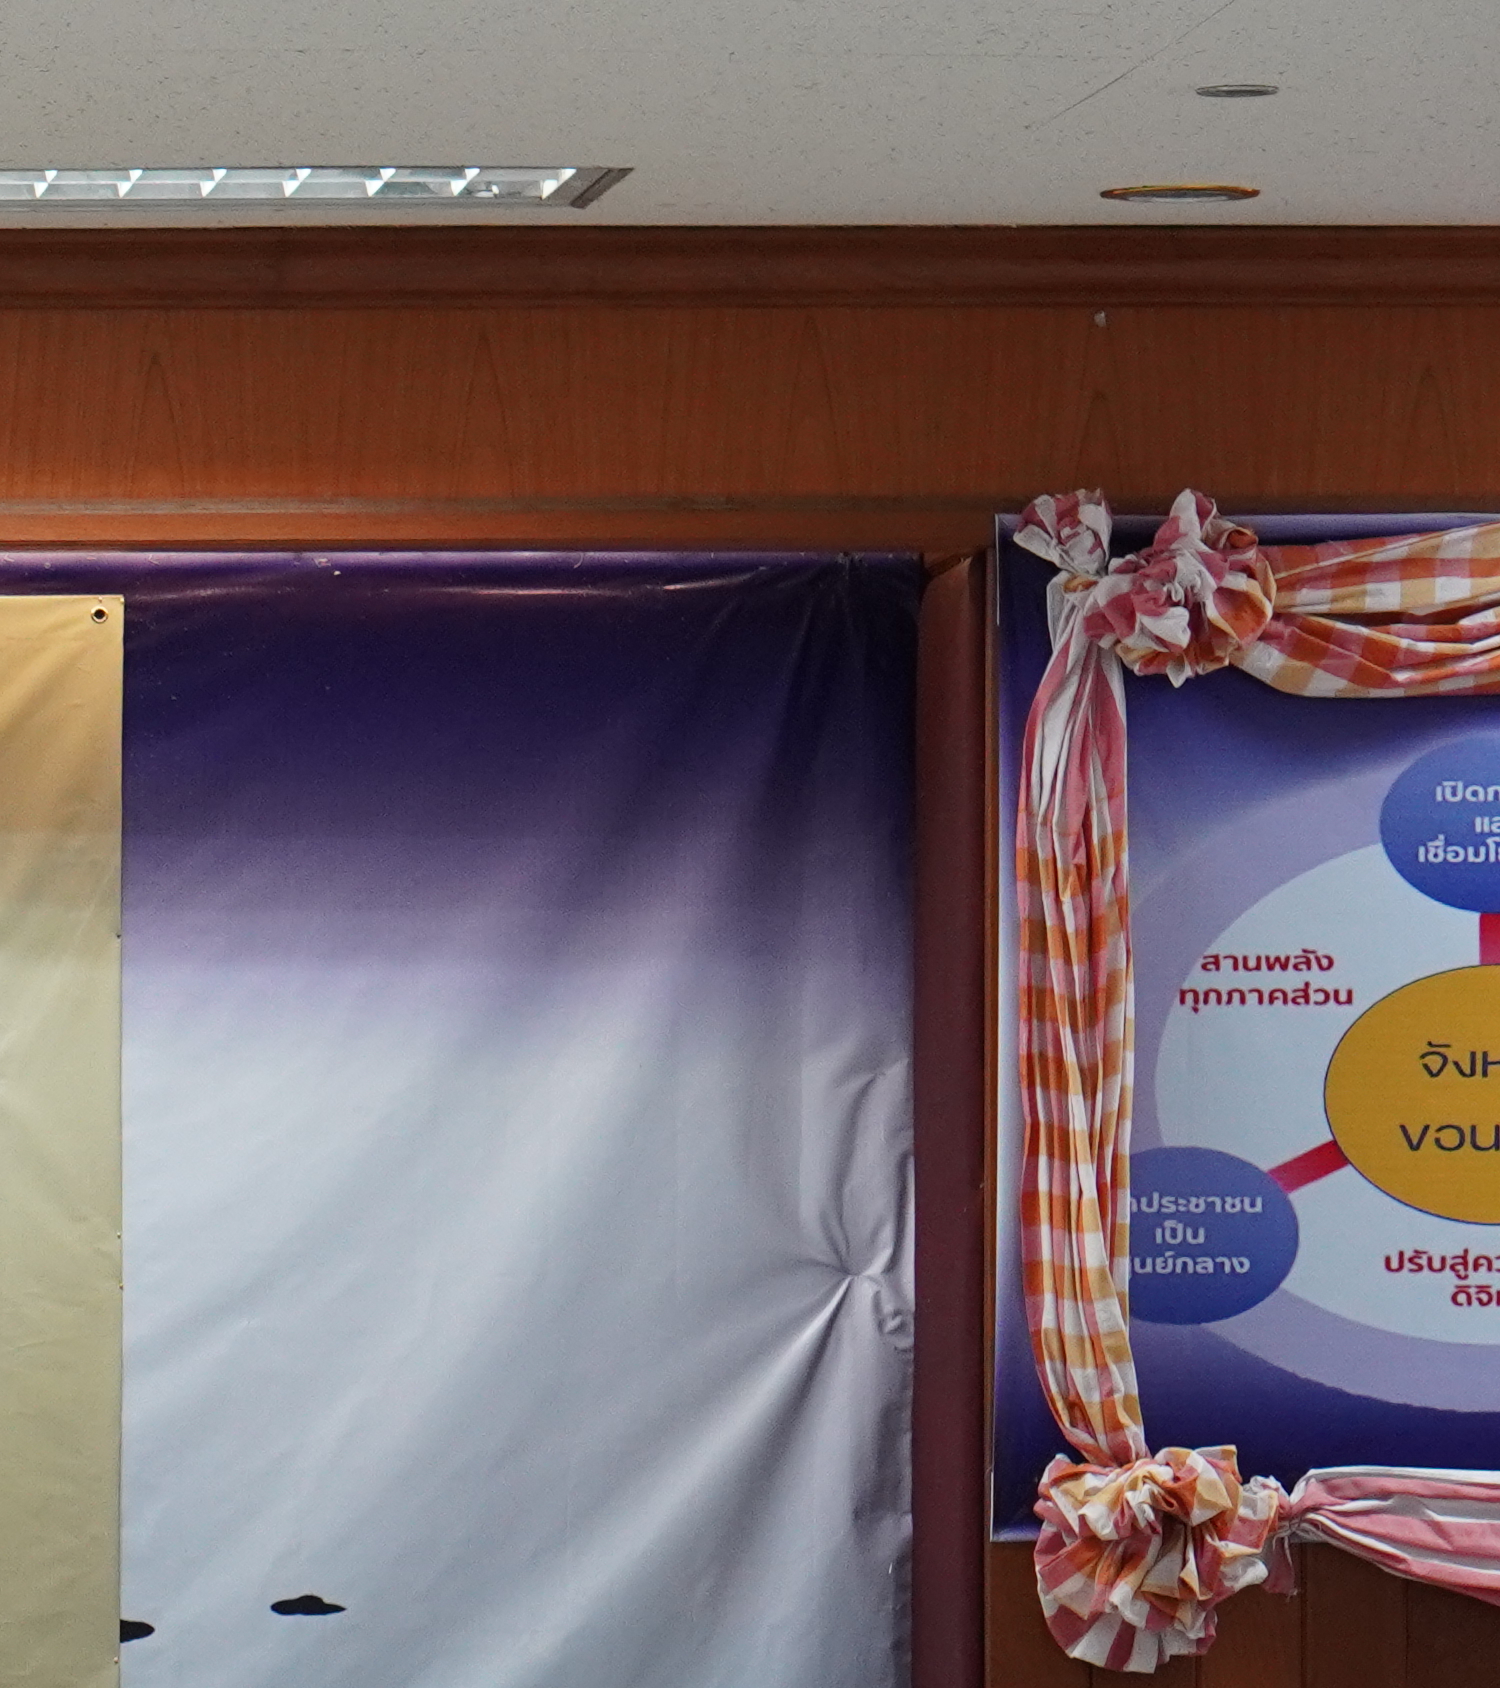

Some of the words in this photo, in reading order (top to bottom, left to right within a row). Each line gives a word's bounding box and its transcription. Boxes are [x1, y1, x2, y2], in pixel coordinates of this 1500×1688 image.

[1417, 833, 1500, 863] เชื่อมโ
[1200, 948, 1336, 973] สานพลัง
[1178, 980, 1354, 1015] ทุกภาคส่วน
[1155, 1219, 1206, 1246] เป็น
[1129, 1250, 1252, 1279] นย์กลาง
[1450, 1284, 1500, 1307] ดิจิ
